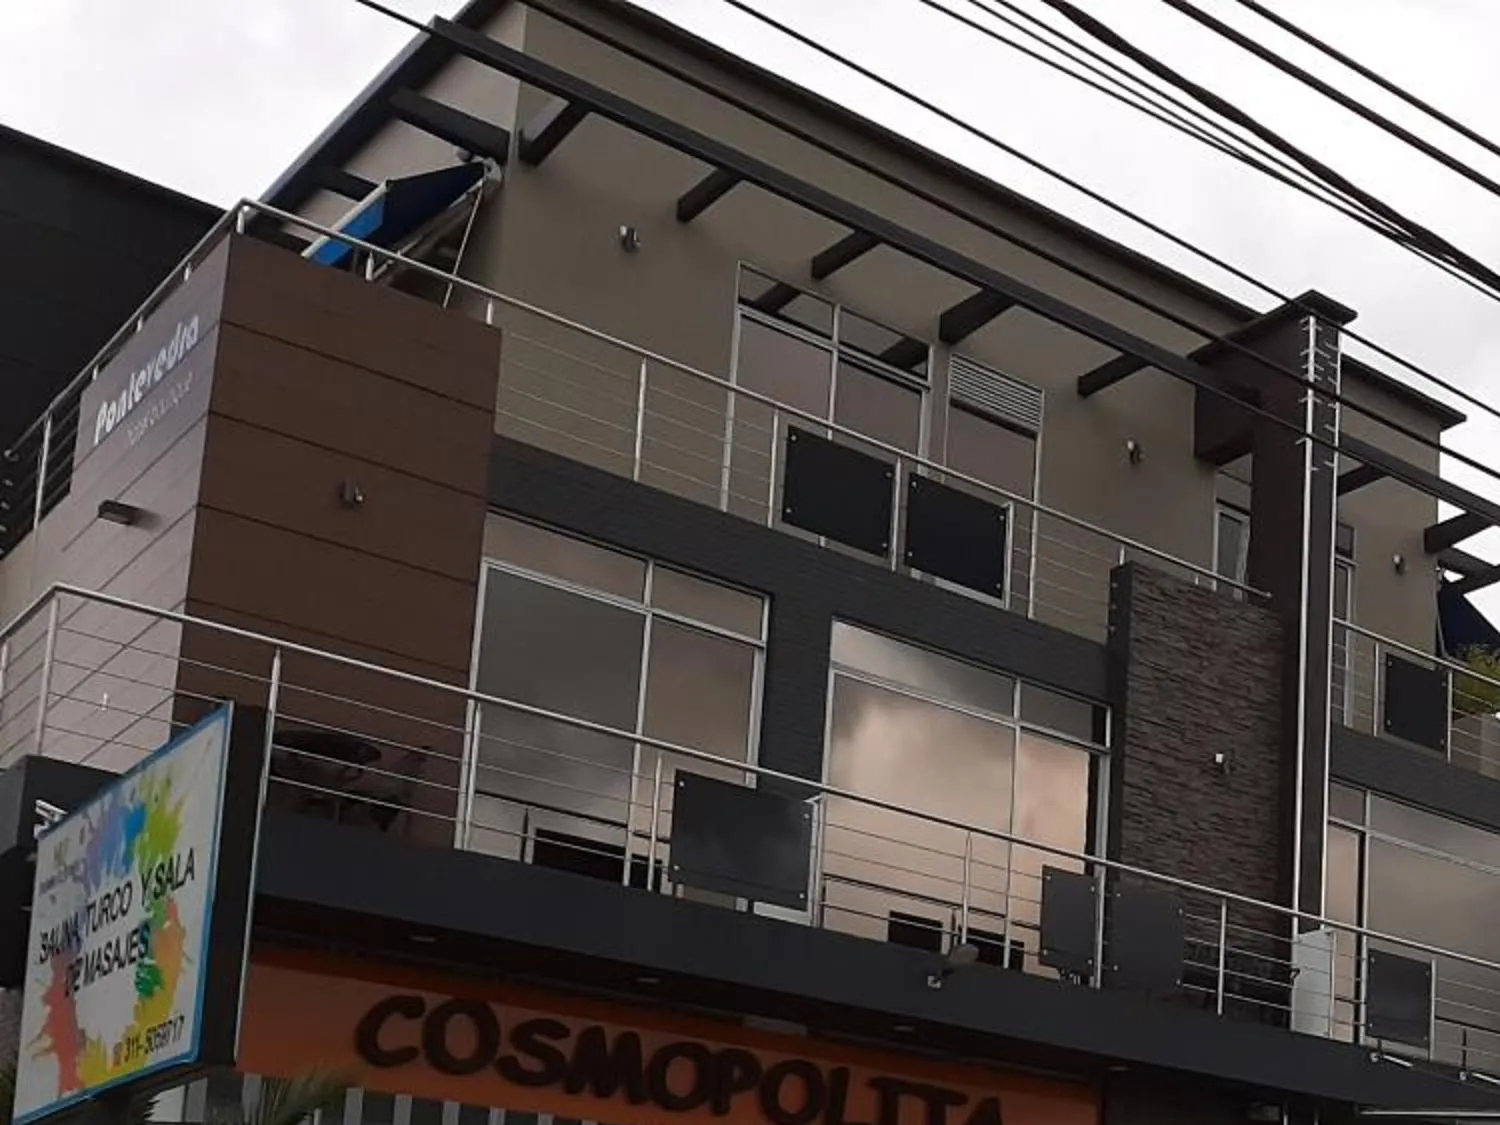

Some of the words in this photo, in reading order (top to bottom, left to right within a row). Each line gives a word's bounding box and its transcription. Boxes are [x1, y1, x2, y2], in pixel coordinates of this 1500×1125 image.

[86, 880, 133, 937] TURCO
[141, 867, 153, 906] Y
[154, 847, 195, 900] SALA
[83, 920, 150, 986] MASAJES
